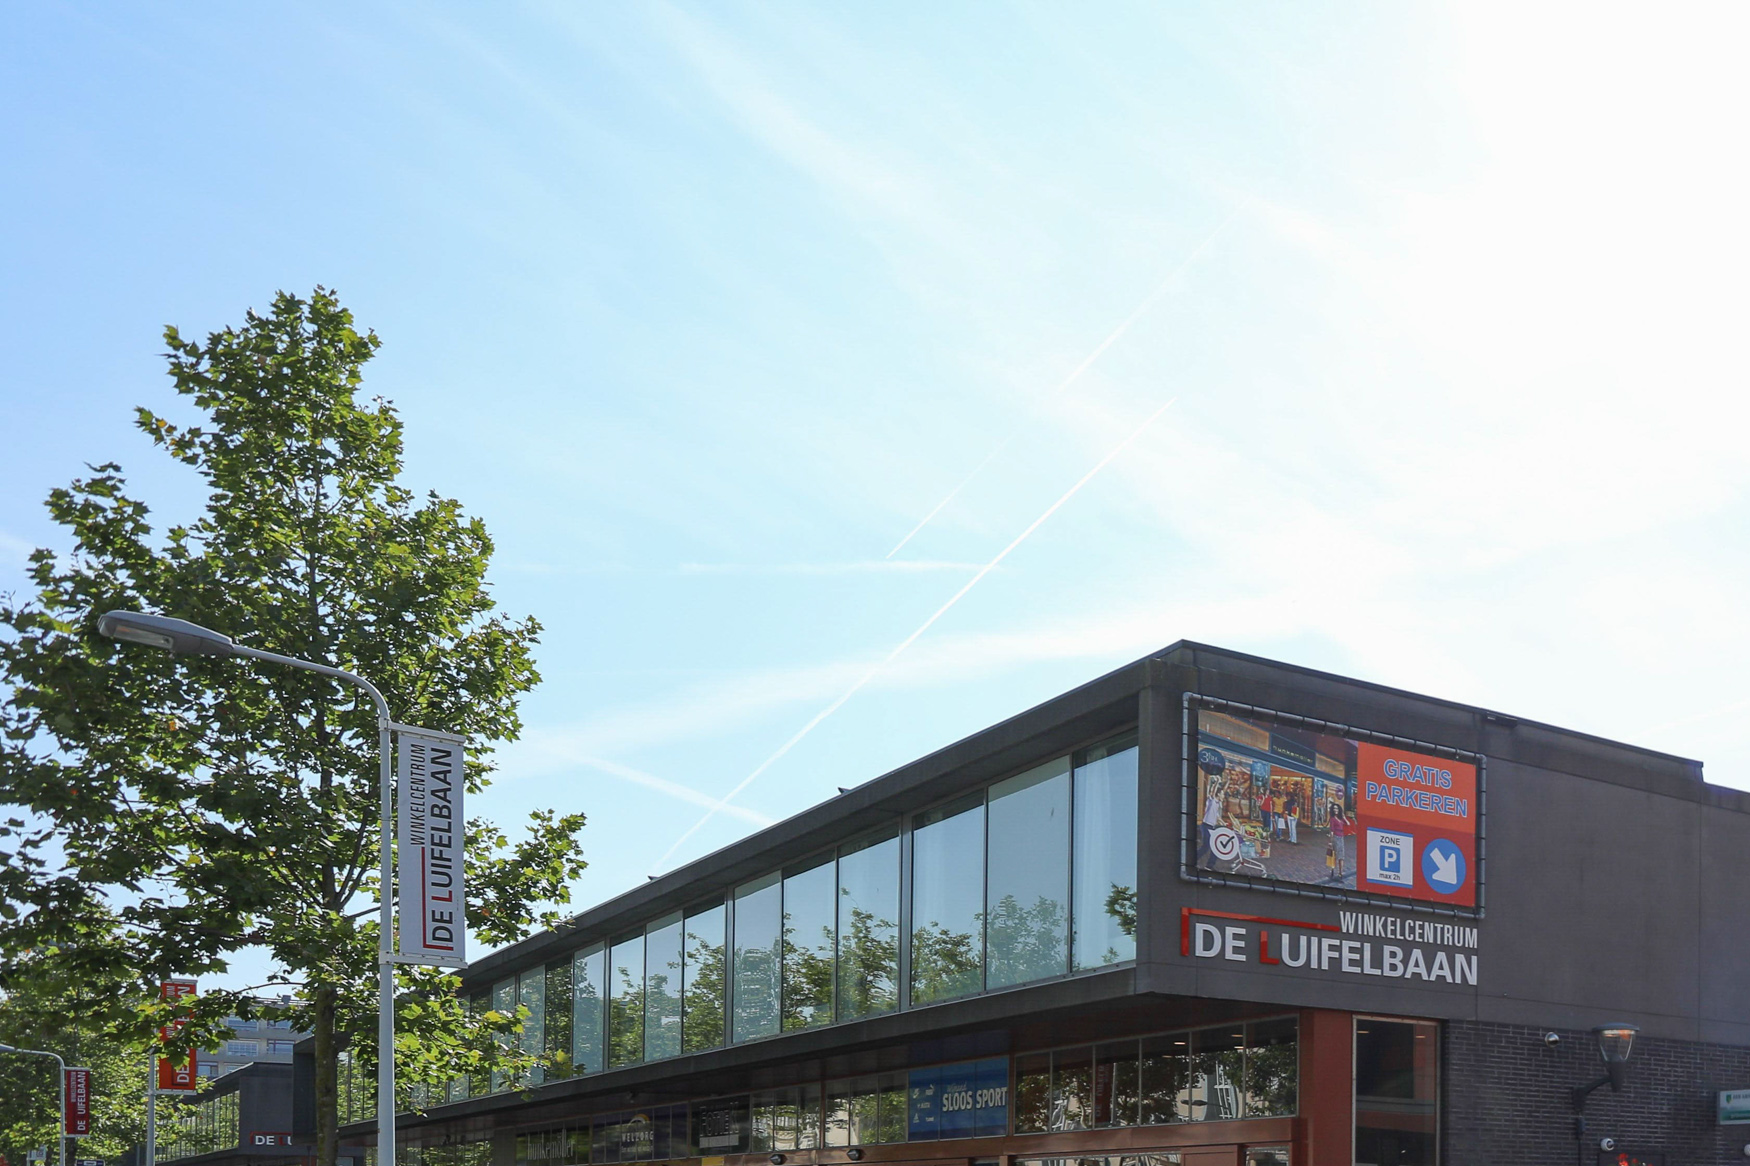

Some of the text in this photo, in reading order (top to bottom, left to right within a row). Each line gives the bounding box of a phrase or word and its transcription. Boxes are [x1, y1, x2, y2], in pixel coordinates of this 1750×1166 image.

[1383, 758, 1452, 790] GRATIS
[410, 743, 426, 846] WINKELCENTRUM
[1366, 781, 1468, 818] PARKEREN
[430, 747, 454, 943] DE LUIFELBAAN
[1380, 835, 1400, 846] ZONE
[1384, 848, 1397, 869] P
[1339, 910, 1478, 949] WINKELCENTRUM
[1194, 922, 1478, 986] DE LUIFELBAAN
[177, 1063, 190, 1083] DE
[942, 1086, 1008, 1112] SLOOS SPORT
[77, 1120, 86, 1131] DE
[255, 1135, 275, 1146] DE
